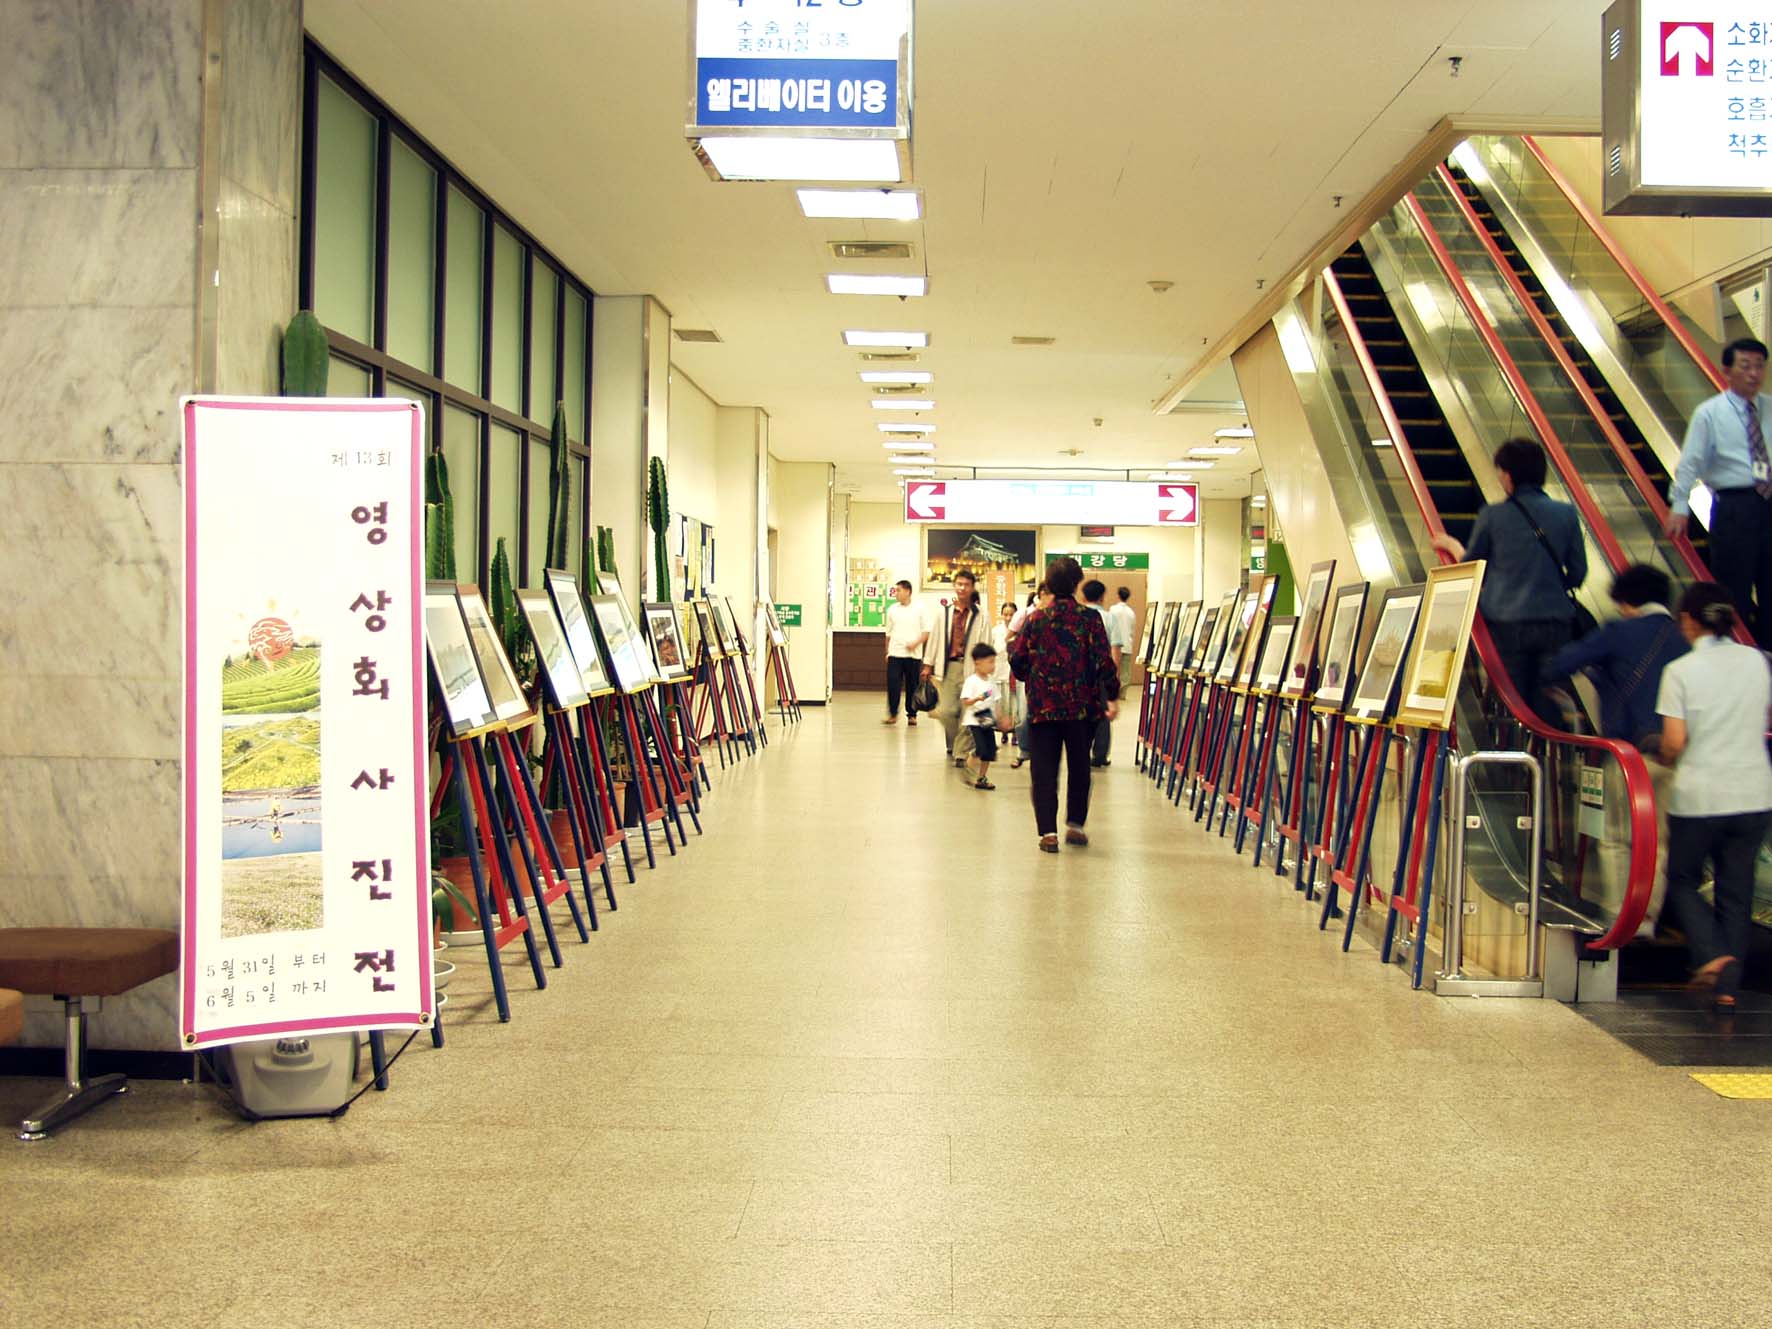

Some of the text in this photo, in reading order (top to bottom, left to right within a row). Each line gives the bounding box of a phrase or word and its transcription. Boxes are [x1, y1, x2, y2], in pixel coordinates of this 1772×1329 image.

[1727, 21, 1772, 46] 소화
[1726, 58, 1772, 83] 순환
[837, 79, 888, 114] 이용
[1727, 96, 1772, 121] 호흡
